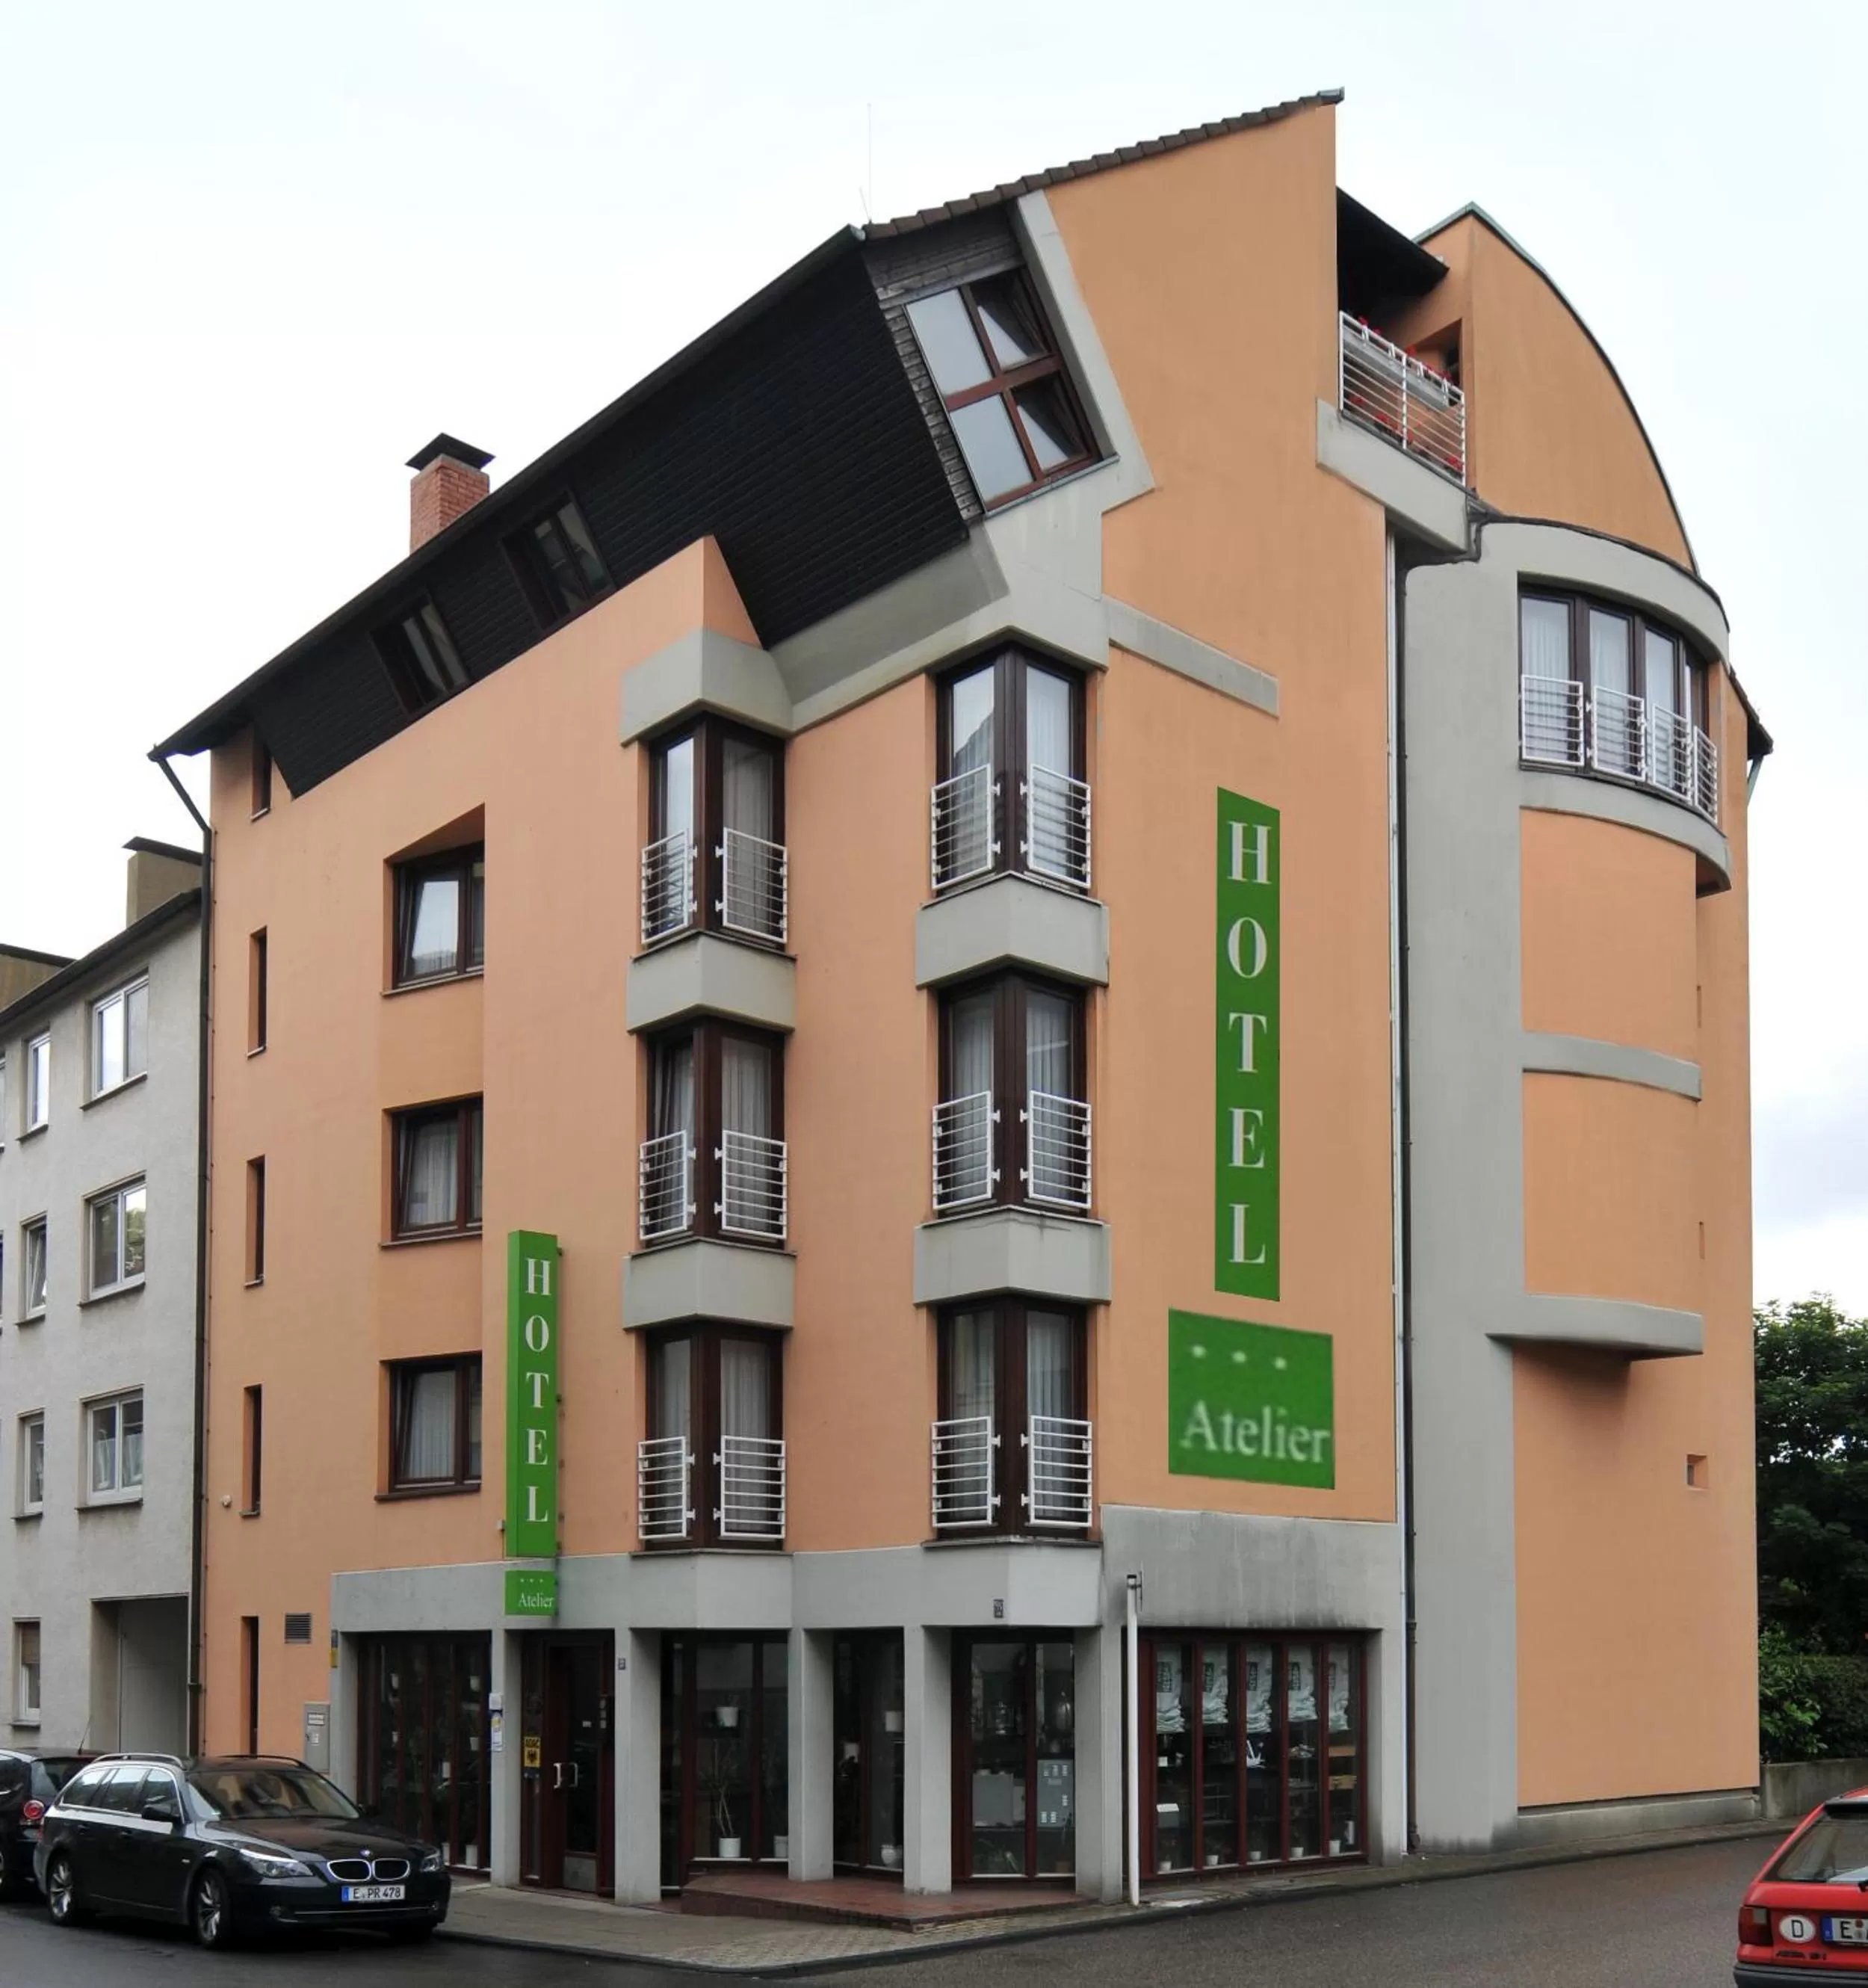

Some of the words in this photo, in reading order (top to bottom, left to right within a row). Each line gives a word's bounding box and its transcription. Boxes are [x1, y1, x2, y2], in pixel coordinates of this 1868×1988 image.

[1226, 821, 1272, 1264] HOTEL
[525, 1257, 551, 1523] HOTEL
[1178, 1400, 1332, 1463] Atelier
[518, 1591, 554, 1608] Atelier
[353, 1888, 360, 1899] E
[367, 1887, 380, 1898] PR
[1791, 1919, 1804, 1938] D
[1840, 1921, 1852, 1939] E
